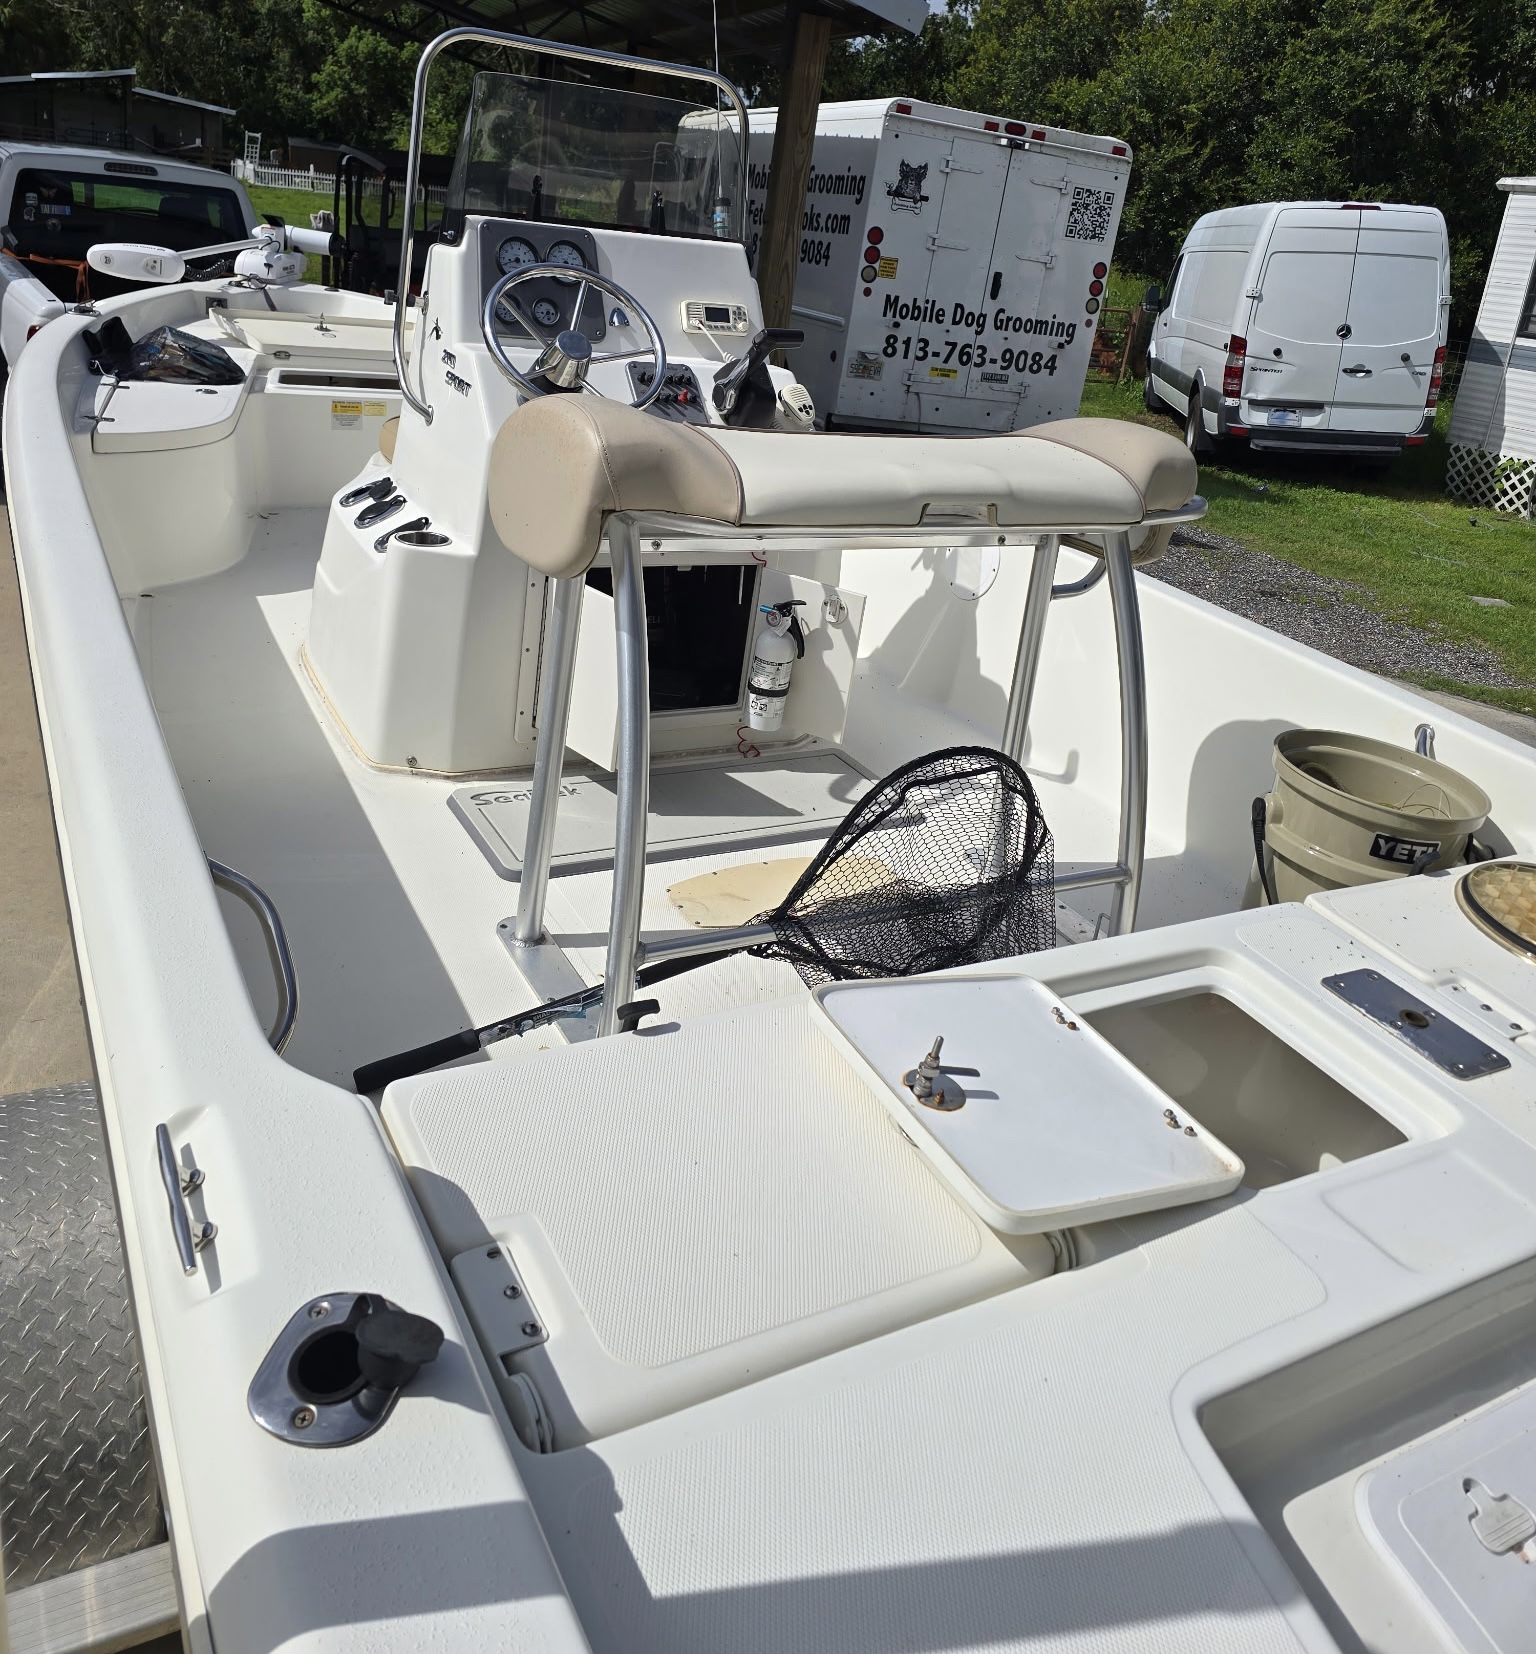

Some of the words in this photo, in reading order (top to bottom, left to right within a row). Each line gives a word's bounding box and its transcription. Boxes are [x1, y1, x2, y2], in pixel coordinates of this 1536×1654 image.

[807, 165, 866, 205] Grooming
[882, 293, 946, 324] Mobile
[951, 302, 987, 336] Dog
[993, 307, 1077, 346] Grooming
[882, 333, 1058, 376] 813-763-9084
[445, 370, 473, 397] SPORT
